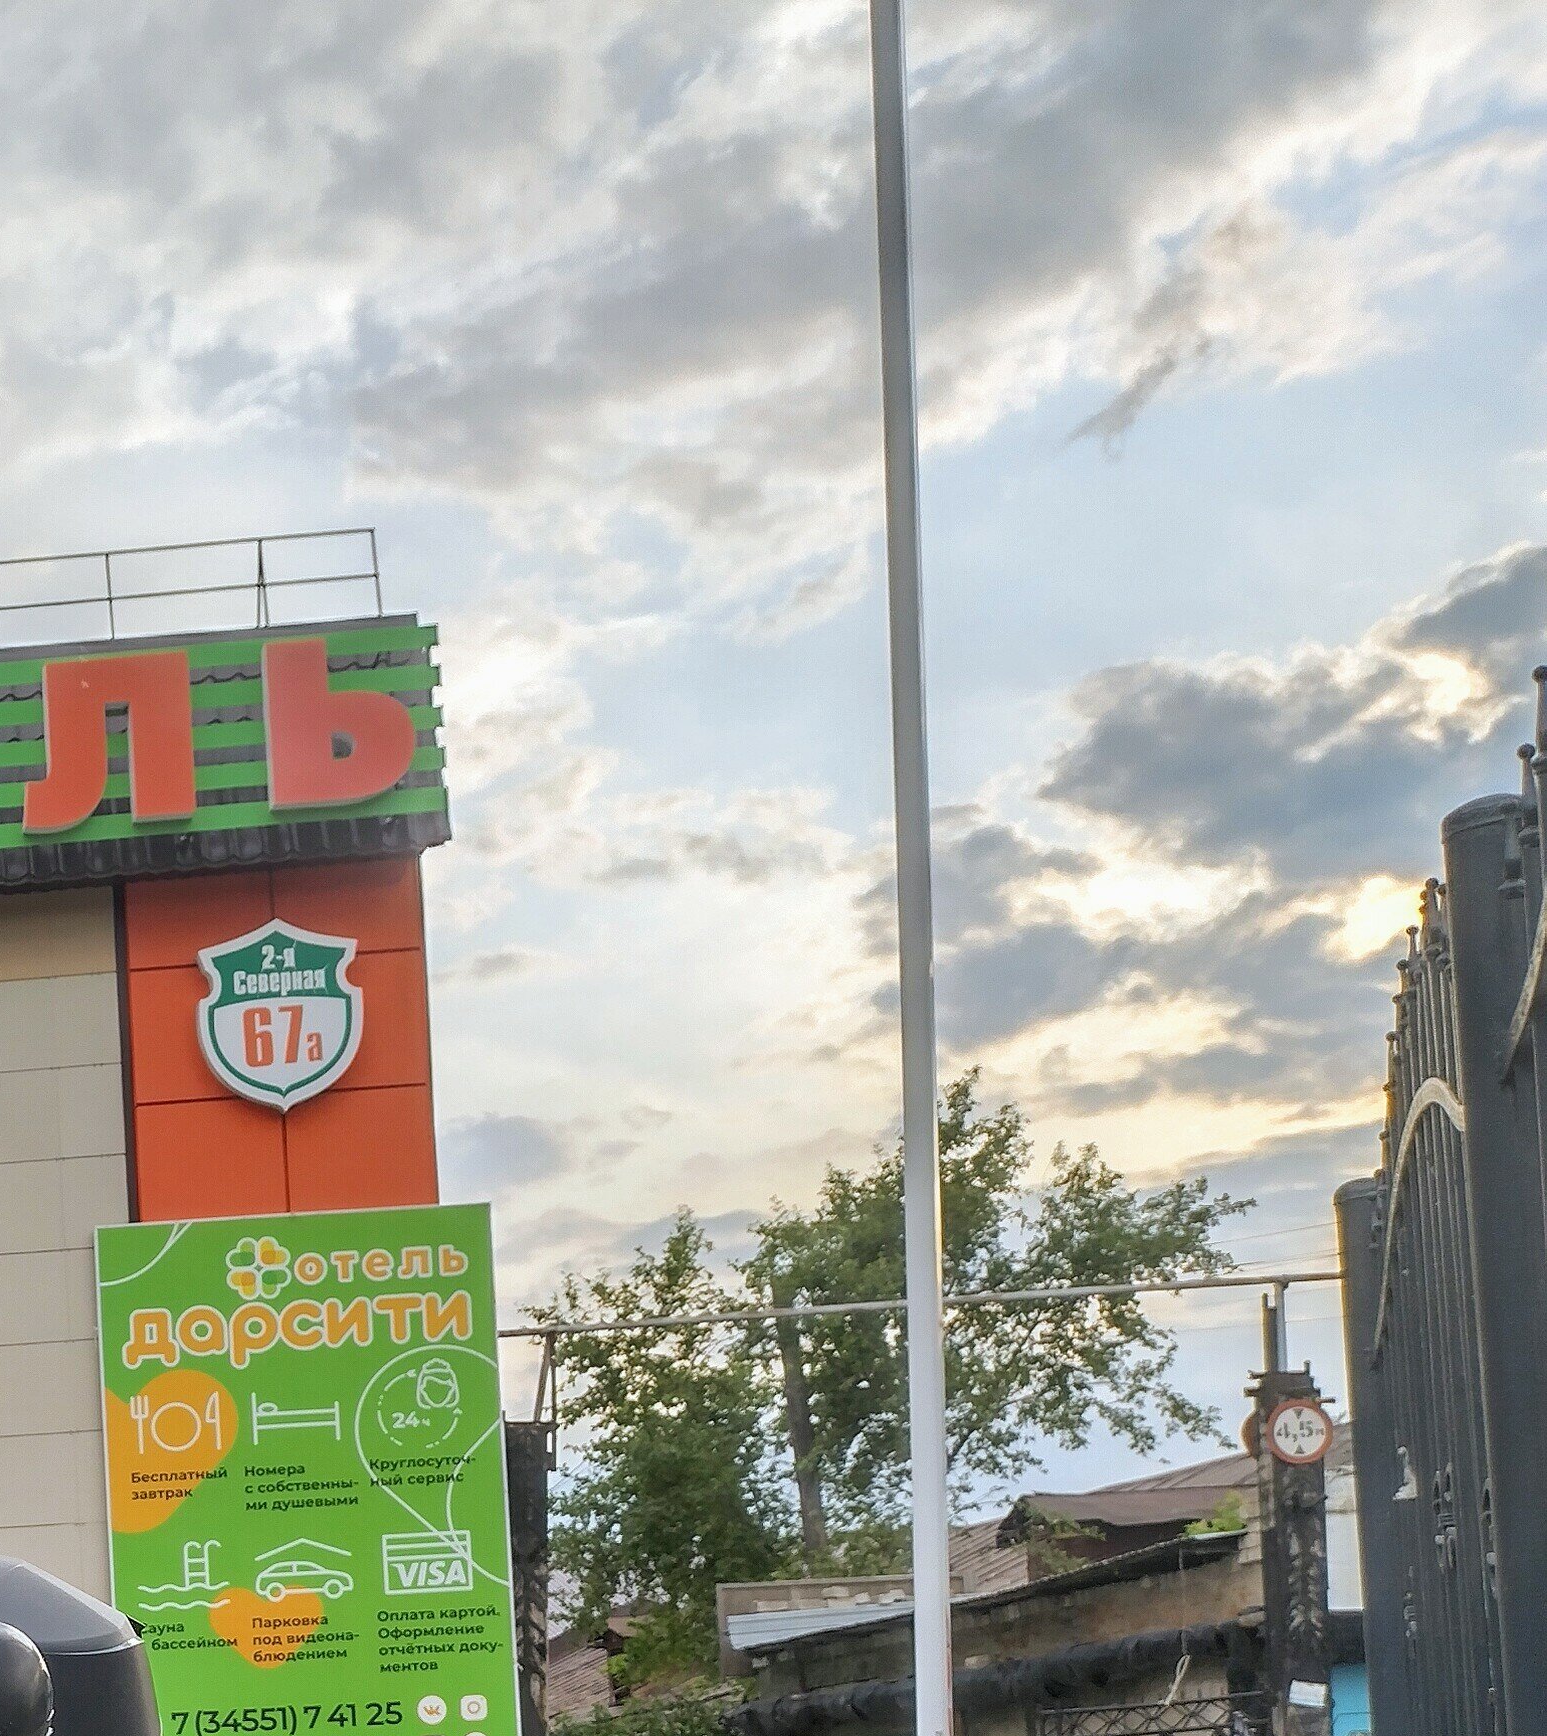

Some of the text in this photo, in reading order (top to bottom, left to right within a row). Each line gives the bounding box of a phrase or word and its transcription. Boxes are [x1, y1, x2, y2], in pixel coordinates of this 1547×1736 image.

[232, 967, 327, 996] Северная
[294, 1244, 469, 1285] отель
[244, 1464, 306, 1478] Номера
[369, 1454, 476, 1472] Круглосуточ-
[130, 1466, 228, 1483] Бесплатный
[407, 1471, 464, 1487] сервис
[131, 1487, 194, 1501] завтрак
[244, 1480, 359, 1494] с собственны-
[245, 1496, 359, 1512] ми душевыми
[390, 1560, 468, 1589] VISA
[252, 1614, 329, 1630] Парковка
[377, 1609, 436, 1623] Оплата
[253, 1630, 360, 1647] под видеона-
[378, 1624, 485, 1641] Оформление
[151, 1636, 238, 1651] бассейном
[459, 1641, 504, 1653] доку-
[253, 1648, 348, 1663] блюдением
[380, 1661, 439, 1673] ментов
[303, 1705, 322, 1729] 7
[327, 1703, 357, 1728] 41
[365, 1700, 404, 1726] 25
